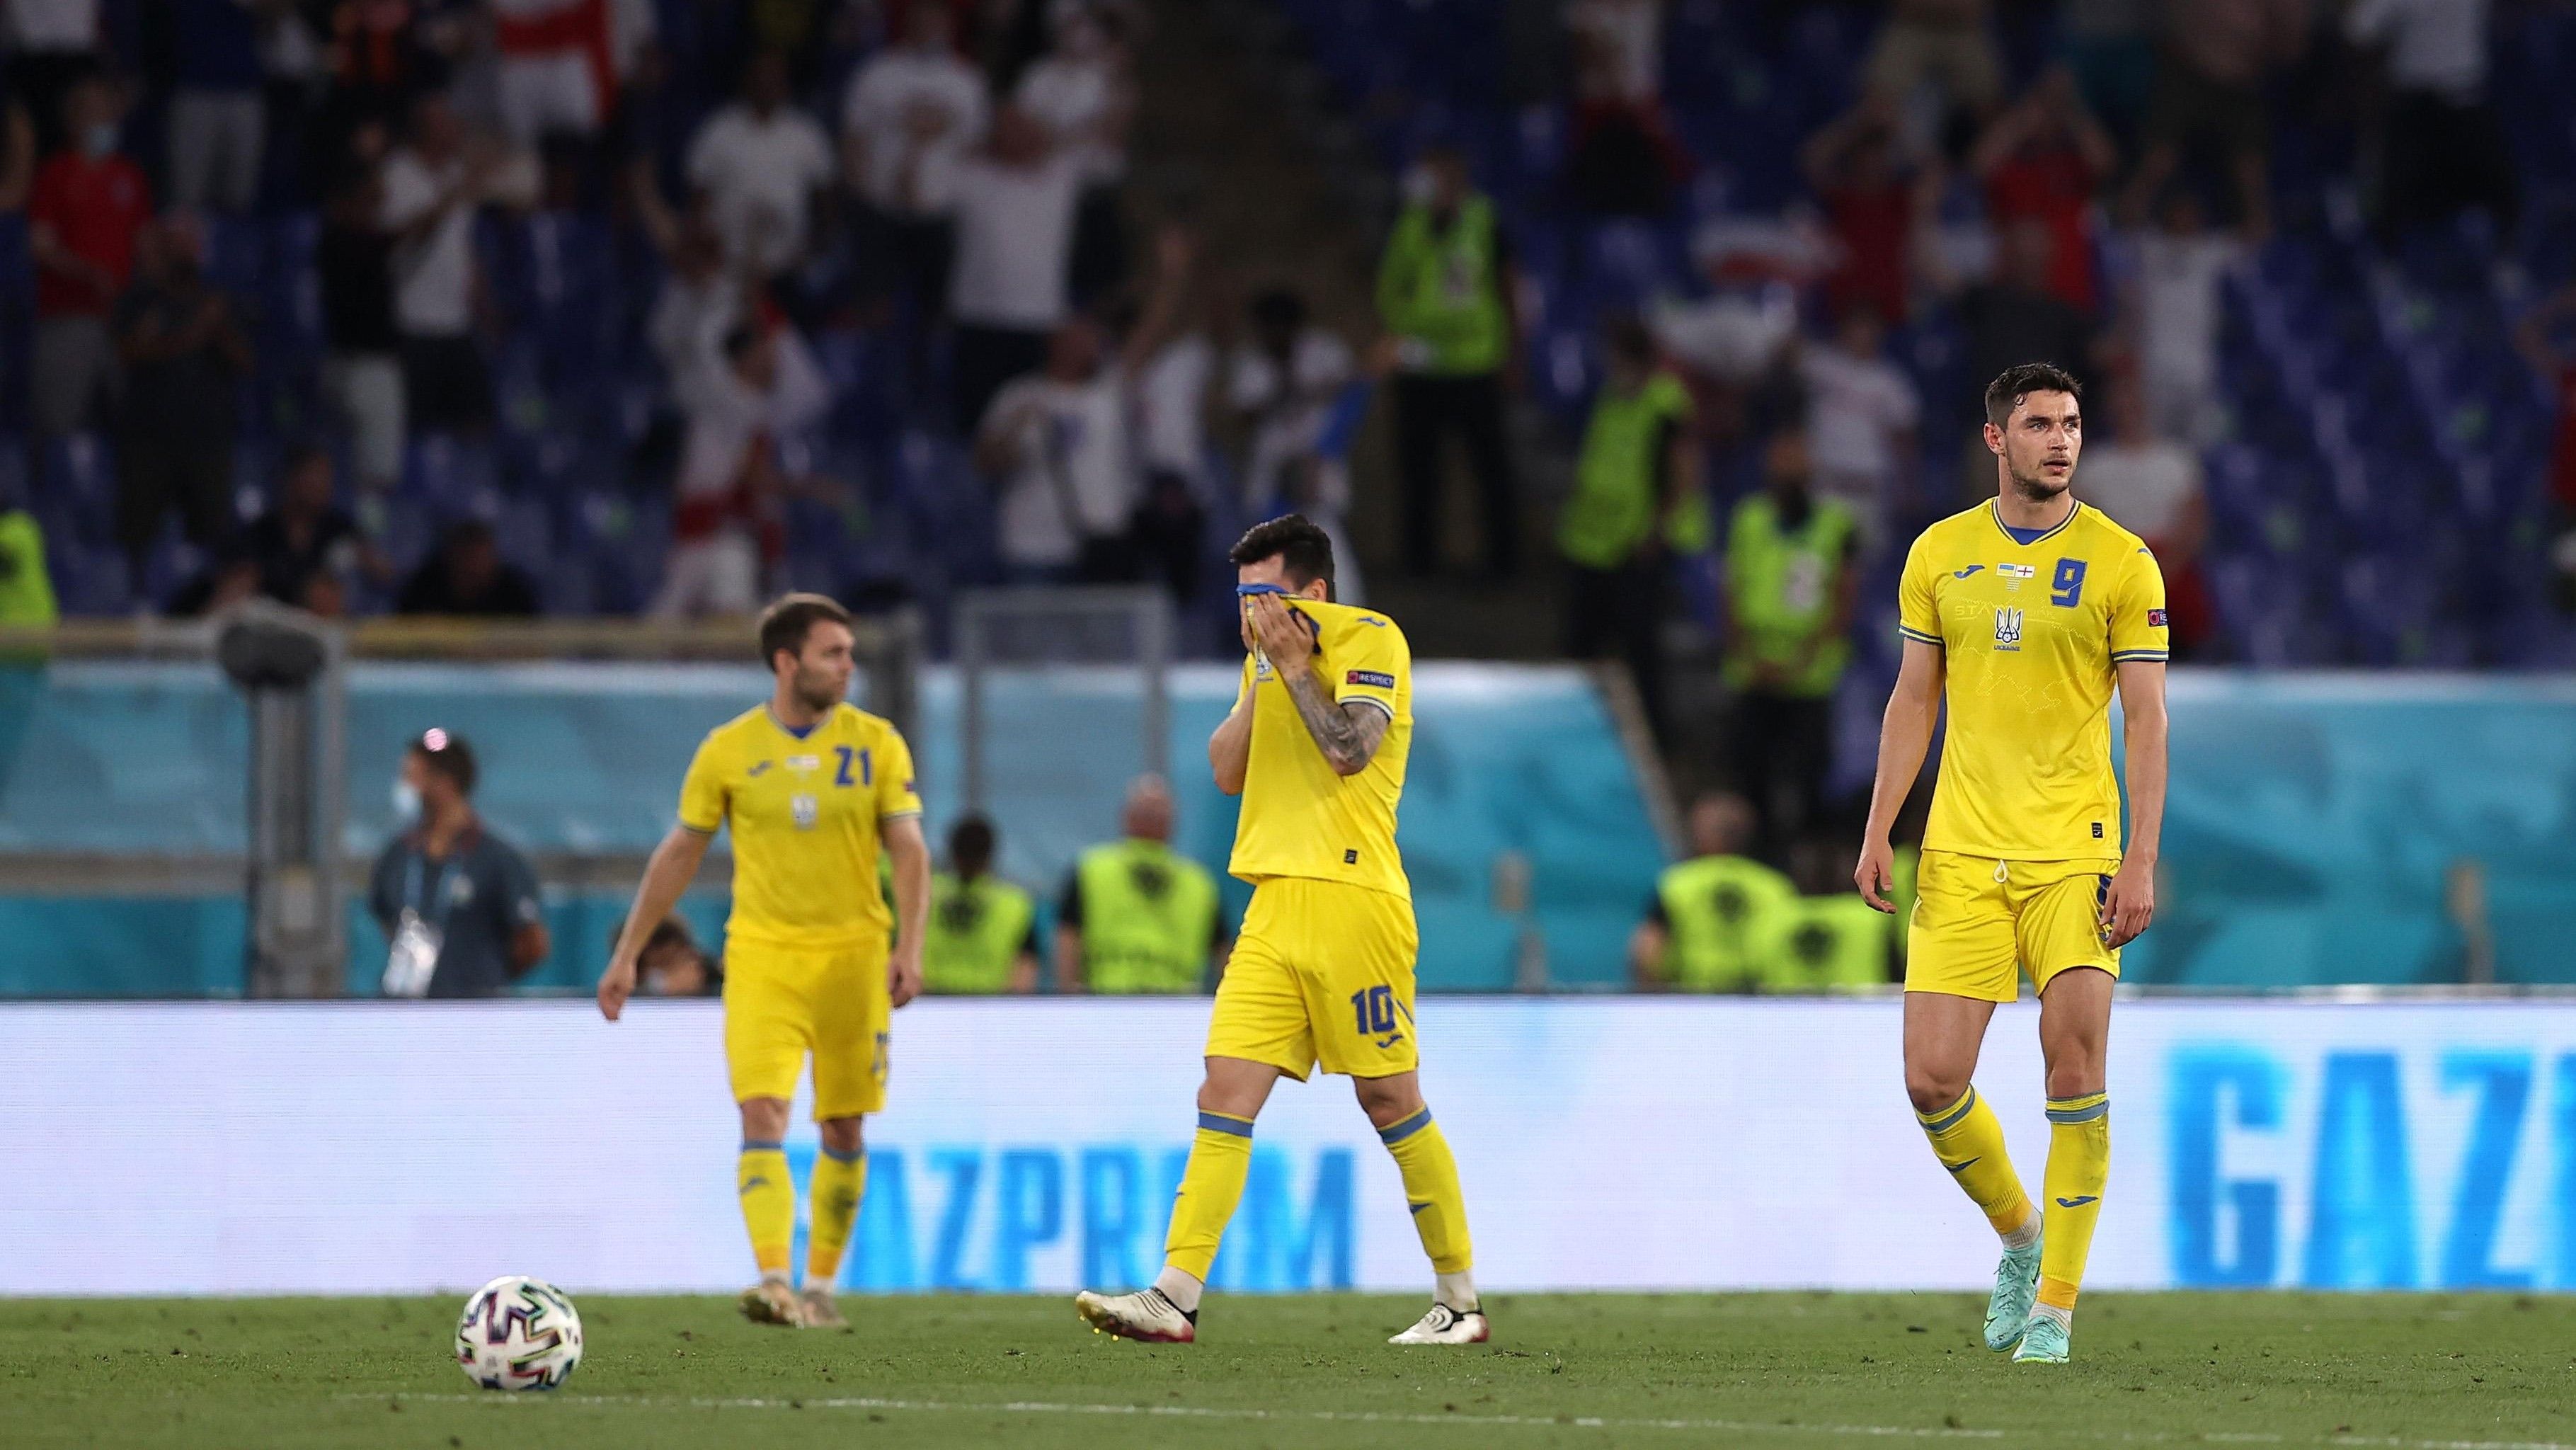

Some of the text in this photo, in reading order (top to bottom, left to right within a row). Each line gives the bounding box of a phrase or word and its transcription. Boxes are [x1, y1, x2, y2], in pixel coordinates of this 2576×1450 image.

[2050, 557, 2088, 609] 9
[835, 747, 871, 785] 21
[1350, 985, 1395, 1034] 10
